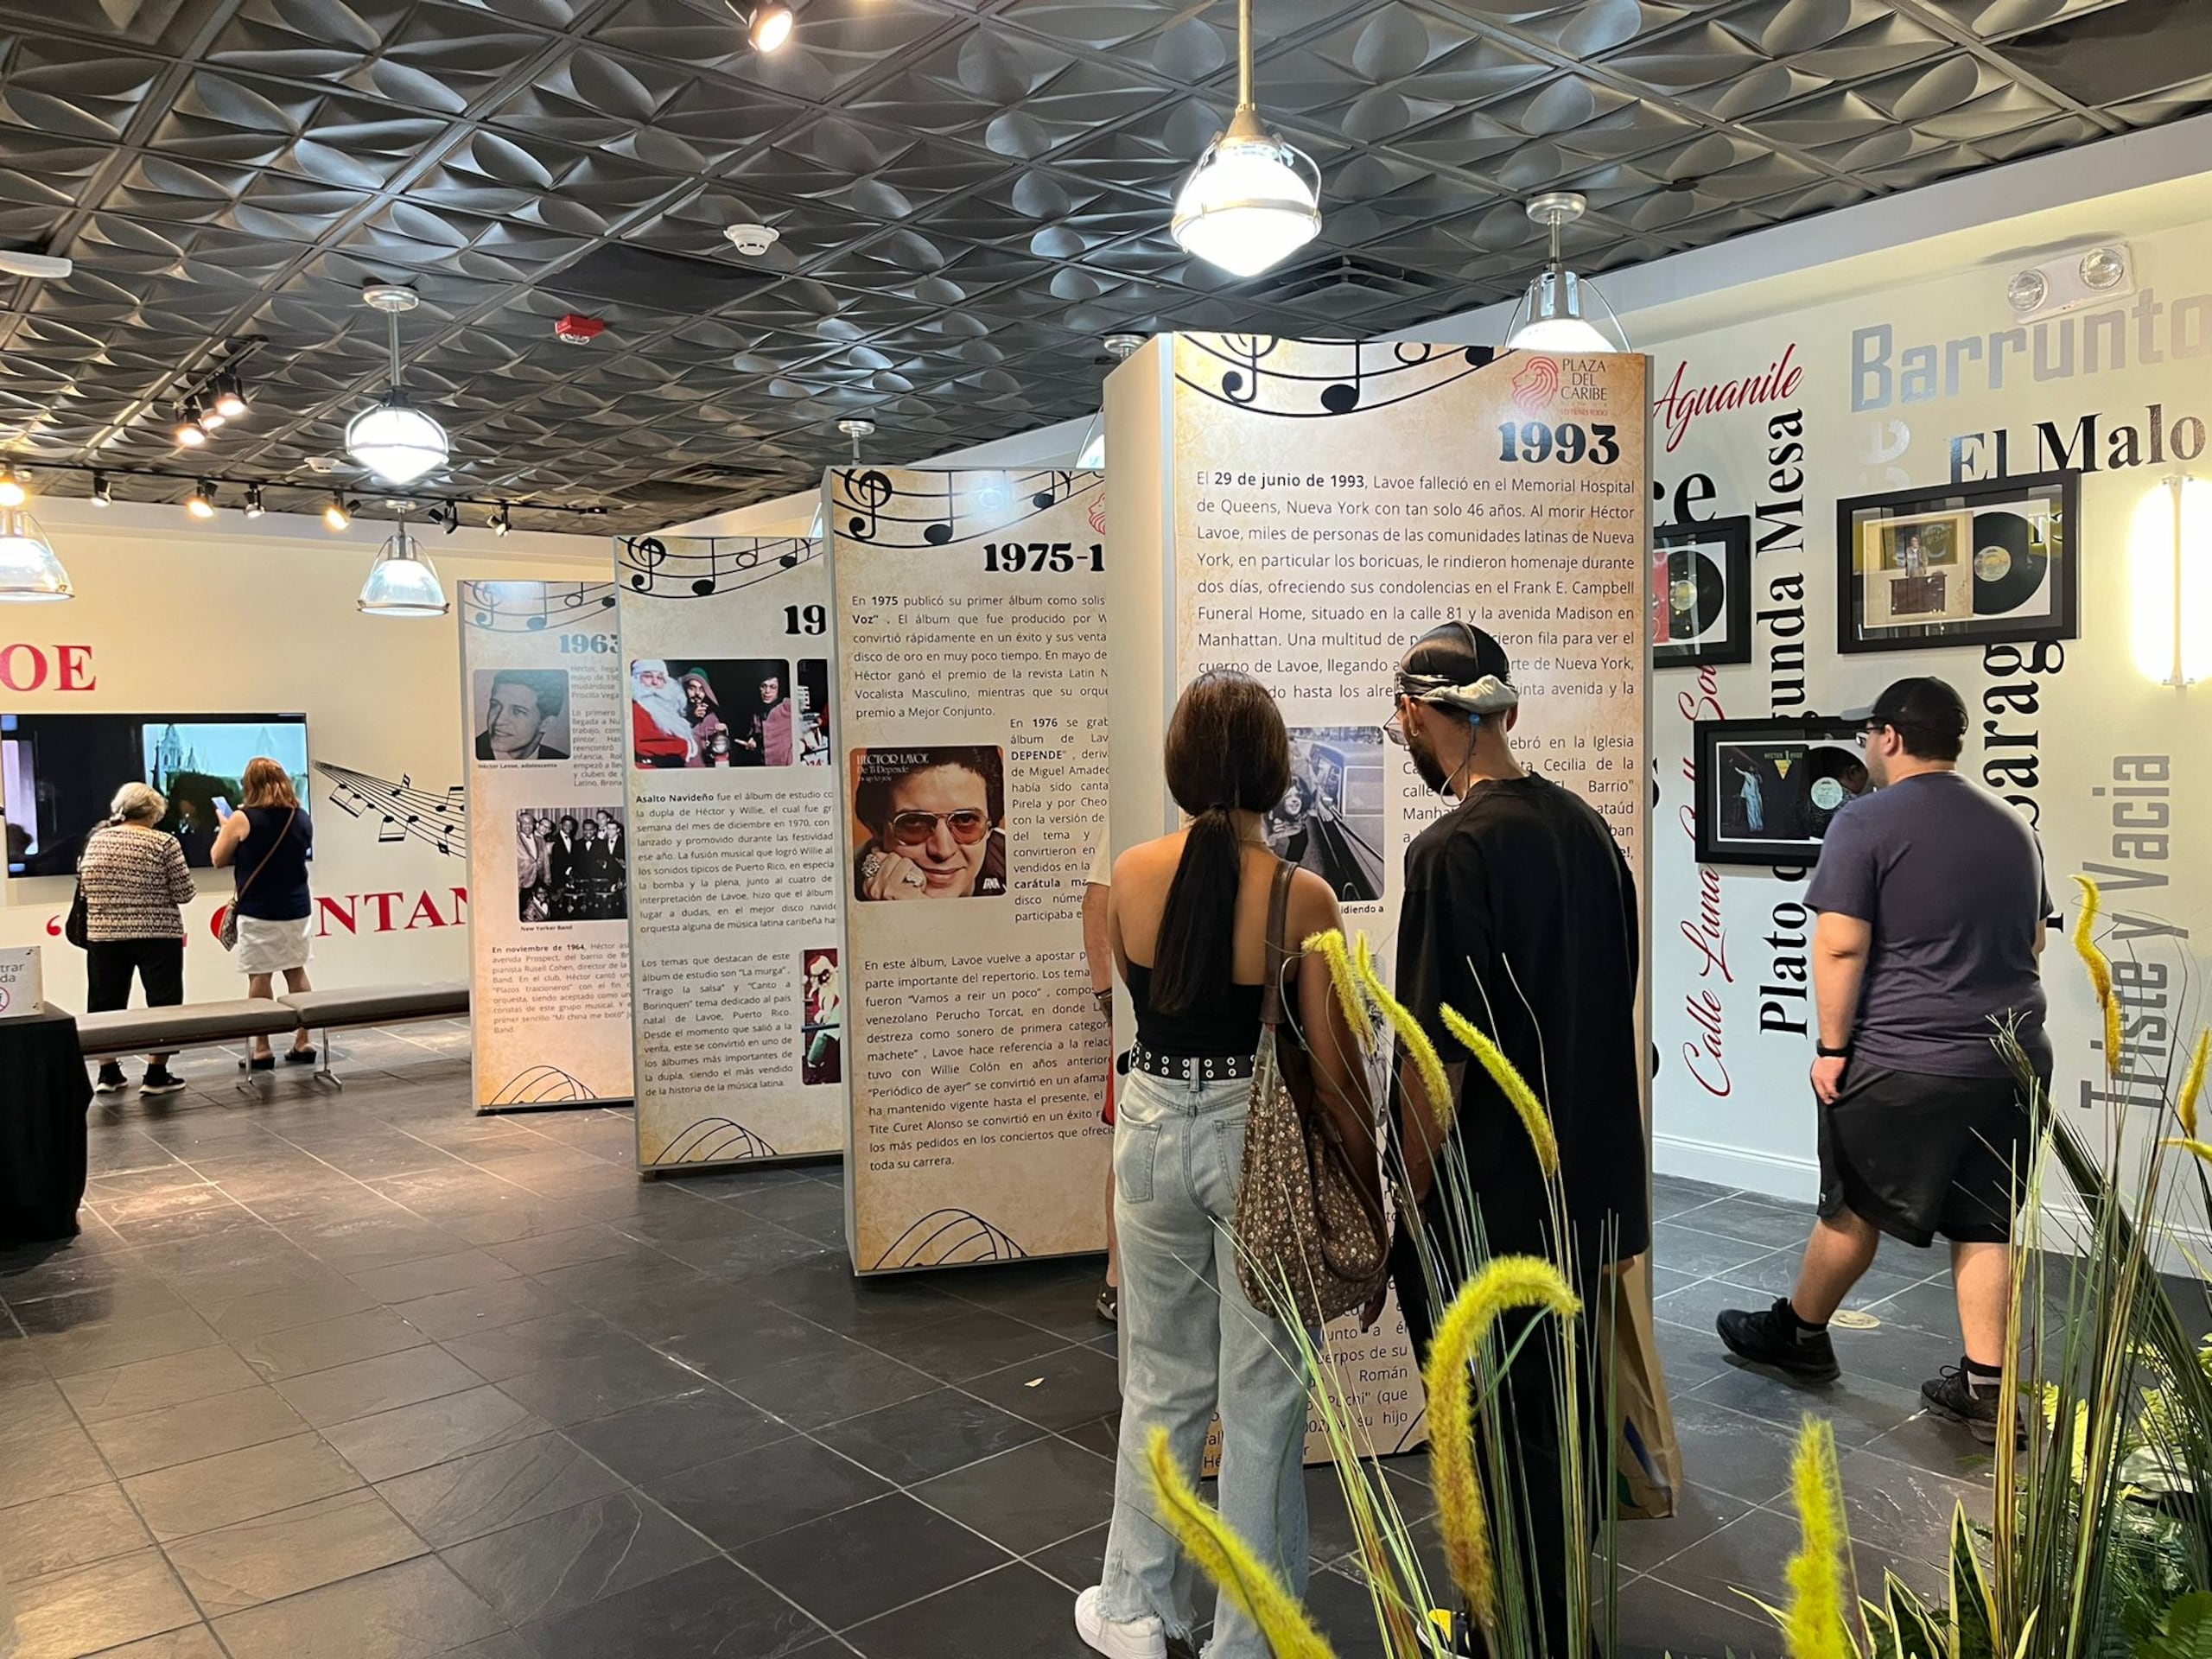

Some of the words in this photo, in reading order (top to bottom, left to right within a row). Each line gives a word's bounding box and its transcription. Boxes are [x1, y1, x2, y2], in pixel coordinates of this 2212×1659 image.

[1852, 288, 2212, 413] Barrunto
[1562, 358, 1606, 372] PLAZA
[1572, 372, 1597, 386] DEL
[1560, 386, 1607, 401] CARIBE
[1653, 343, 1803, 453] Aguanile
[1497, 421, 1620, 465] 1993
[1950, 429, 2010, 486] El
[2033, 404, 2206, 474] Malo
[1197, 471, 1208, 485] El
[1215, 472, 1232, 486] 29
[1237, 472, 1256, 486] de
[1260, 473, 1300, 490] junio
[1306, 474, 1325, 487] de
[1331, 474, 1368, 490] 1993,
[1374, 475, 1414, 489] Lavoe
[1420, 475, 1468, 491] falleció
[1473, 480, 1490, 491] en
[1495, 477, 1506, 491] el
[1512, 478, 1575, 493] Memorial
[1580, 480, 1634, 497] Hospital
[1755, 408, 1804, 559] Mesa
[1197, 498, 1215, 512] de
[1221, 499, 1281, 515] Queens,
[1287, 500, 1332, 514] Nueva
[1338, 501, 1370, 515] York
[1375, 505, 1400, 515] con
[1406, 504, 1428, 516] tan
[1433, 502, 1462, 517] solo
[1466, 503, 1484, 517] 46
[1489, 504, 1525, 518] años.
[1530, 504, 1543, 518] Al
[1548, 505, 1586, 518] morir
[1591, 505, 1635, 518] Héctor
[1198, 526, 1243, 541] Lavoe,
[1249, 525, 1287, 540] miles
[1291, 526, 1309, 540] de
[1313, 530, 1379, 544] personas
[1382, 528, 1401, 542] de
[1405, 528, 1424, 542] las
[1427, 529, 1520, 543] comunidades
[1524, 529, 1568, 543] latinas
[1572, 531, 1589, 543] de
[1592, 531, 1634, 544] Nueva
[983, 542, 1105, 572] 1975-1
[1197, 552, 1233, 568] York,
[1238, 556, 1256, 567] en
[1262, 553, 1331, 570] particular
[1335, 554, 1355, 568] los
[1359, 554, 1422, 569] boricuas,
[1427, 554, 1439, 568] le
[1444, 555, 1506, 569] rindieron
[1511, 555, 1578, 573] homenaje
[1582, 556, 1634, 569] durante
[1198, 579, 1224, 594] dos
[1230, 579, 1262, 594] días,
[1268, 579, 1345, 594] ofreciendo
[1351, 583, 1375, 594] sus
[1379, 580, 1471, 594] condolencias
[1475, 583, 1491, 594] en
[1497, 581, 1508, 594] el
[1514, 581, 1551, 594] Frank
[1556, 581, 1567, 594] E.
[1572, 581, 1634, 598] Campbell
[852, 595, 866, 606] En
[872, 596, 899, 606] 1975
[904, 595, 944, 607] publicó
[949, 597, 962, 606] su
[967, 597, 1003, 608] primer
[1008, 595, 1043, 606] álbum
[1047, 597, 1077, 606] como
[784, 605, 827, 635] 19
[1198, 607, 1252, 620] Funeral
[1259, 607, 1306, 621] Home,
[1312, 607, 1364, 620] situado
[1370, 609, 1387, 620] en
[1394, 607, 1405, 620] la
[1410, 606, 1441, 620] calle
[1446, 607, 1462, 621] 81
[1468, 609, 1477, 623] y
[1481, 606, 1492, 620] la
[1498, 607, 1550, 620] avenida
[1556, 607, 1612, 620] Madison
[1618, 609, 1634, 620] en
[855, 671, 892, 681] Héctor
[898, 670, 925, 683] ganó
[931, 670, 941, 680] el
[948, 671, 987, 682] premio
[993, 669, 1007, 679] de
[1013, 669, 1022, 679] la
[1028, 670, 1063, 678] revista
[1069, 669, 1095, 678] Latin
[856, 707, 896, 720] premio
[908, 707, 940, 720] Mejor
[943, 706, 995, 719] Conjunto.
[1010, 718, 1023, 728] En
[1033, 718, 1058, 728] 1976
[1066, 719, 1078, 728] se
[1593, 734, 1634, 752] Iglesia
[1544, 758, 1586, 772] Cecilia
[1588, 779, 1634, 793] Barrio"
[669, 793, 714, 802] Navideño
[717, 792, 731, 801] fue
[775, 791, 786, 800] de
[789, 791, 822, 799] estudio
[1012, 798, 1042, 809] Pirela
[1046, 800, 1052, 810] y
[1058, 799, 1076, 810] por
[1080, 797, 1108, 807] Cheo
[2082, 754, 2170, 892] Vacia
[1681, 863, 1733, 982] Luna
[2112, 912, 2190, 941] y
[1759, 902, 1808, 1039] Plato
[1682, 989, 1731, 1096] Calle
[868, 1071, 892, 1080] tuvo
[901, 1069, 921, 1077] con
[931, 1065, 960, 1075] Willie
[969, 1062, 1000, 1073] Colón
[1009, 1062, 1023, 1071] en
[1032, 1058, 1058, 1069] años
[870, 1160, 894, 1171] toda
[897, 1160, 910, 1169] su
[912, 1157, 954, 1167] carrera.
[1359, 1366, 1408, 1382] Román
[1383, 1411, 1408, 1427] hijo
